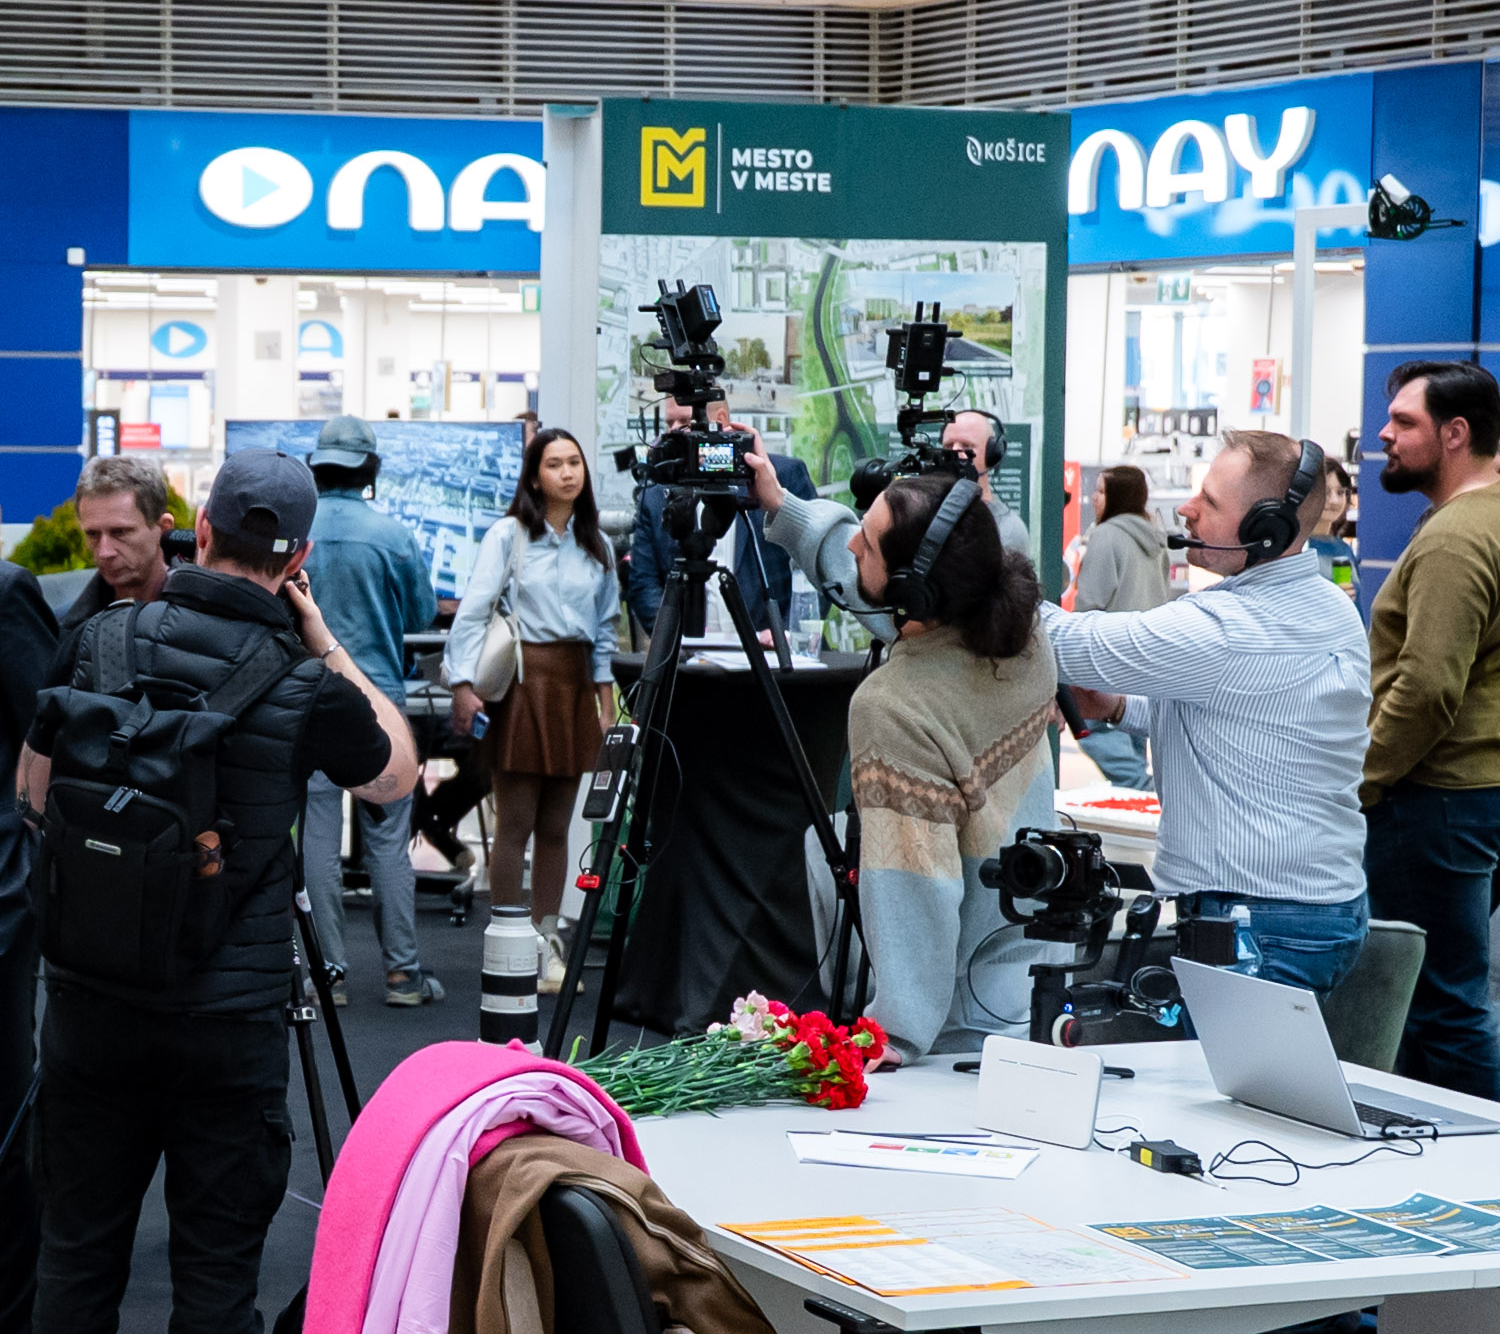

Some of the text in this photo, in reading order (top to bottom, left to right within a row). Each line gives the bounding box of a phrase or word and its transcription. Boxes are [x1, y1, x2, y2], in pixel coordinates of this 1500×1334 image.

[731, 148, 813, 169] MESTO
[984, 138, 1046, 164] KOŠICE
[1068, 105, 1317, 215] NAY
[730, 171, 832, 193] V MESTE
